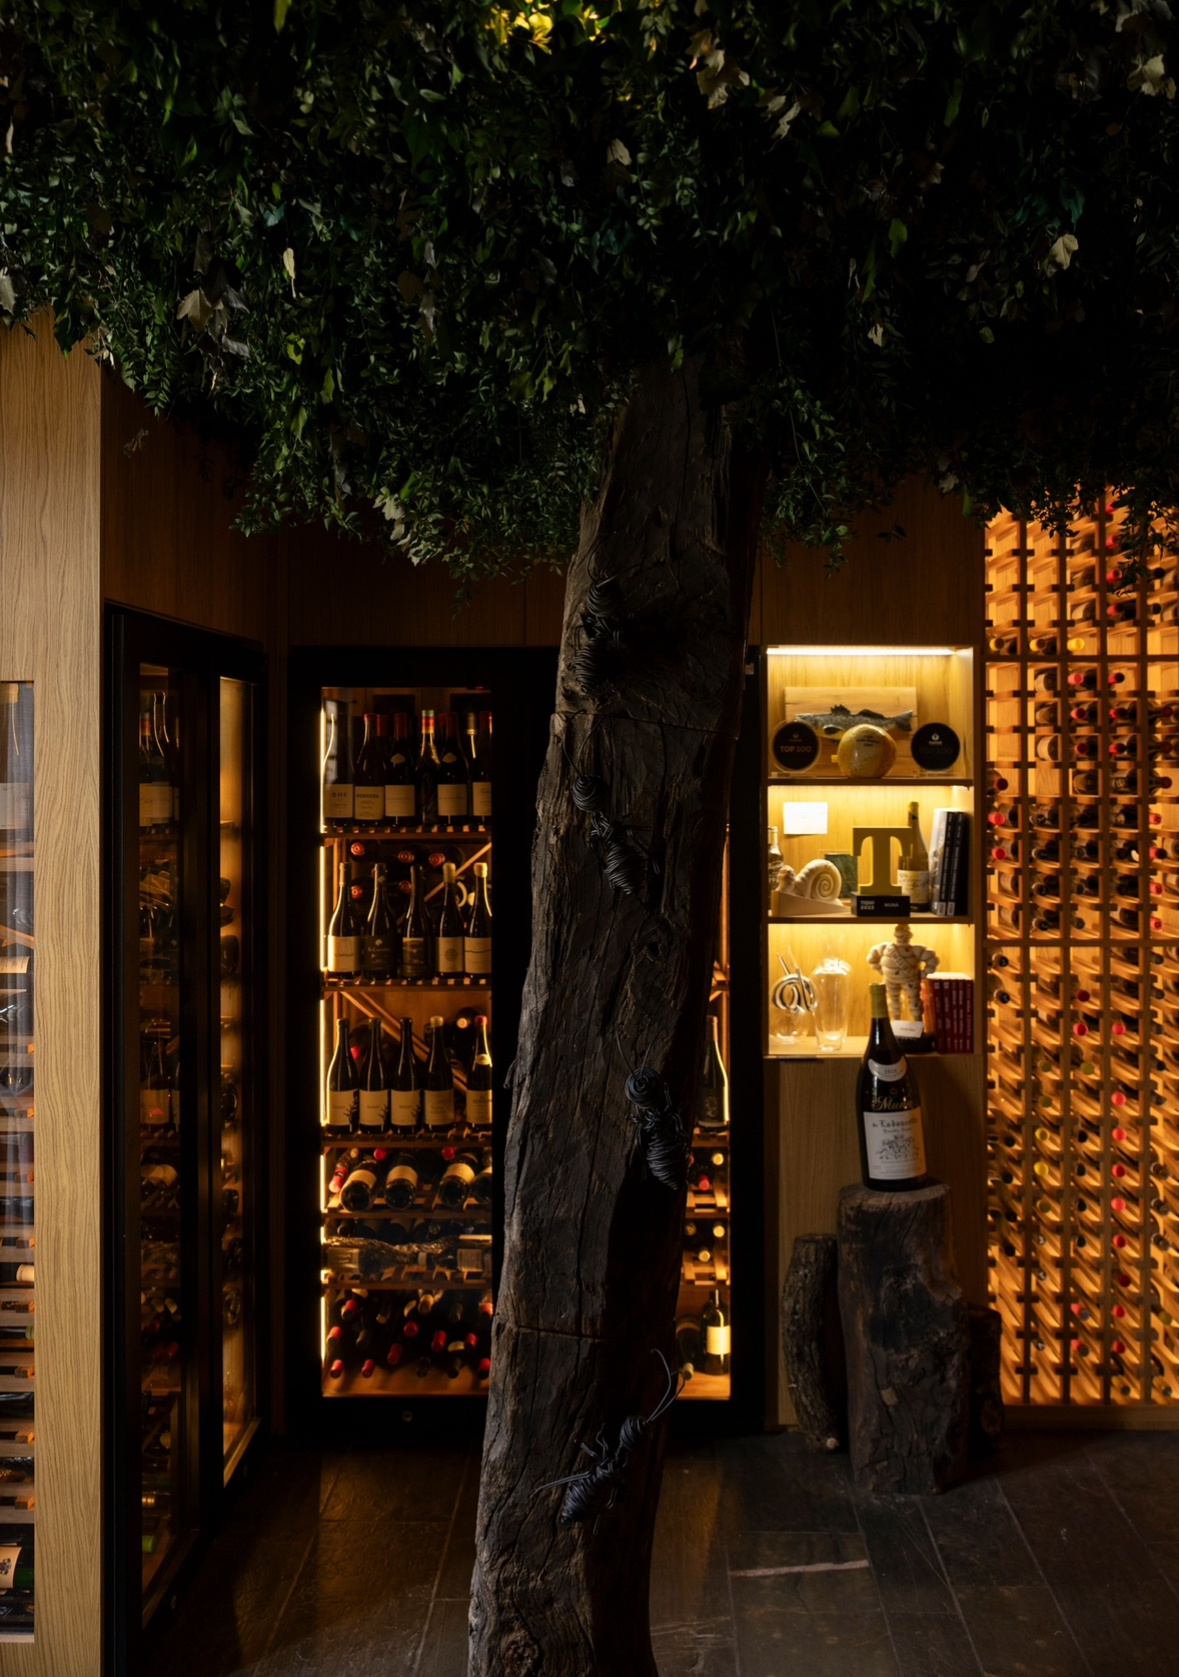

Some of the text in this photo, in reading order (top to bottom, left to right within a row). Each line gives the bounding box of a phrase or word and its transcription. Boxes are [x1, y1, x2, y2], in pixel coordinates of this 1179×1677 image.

[779, 745, 812, 753] TOP 100
[852, 827, 912, 894] T
